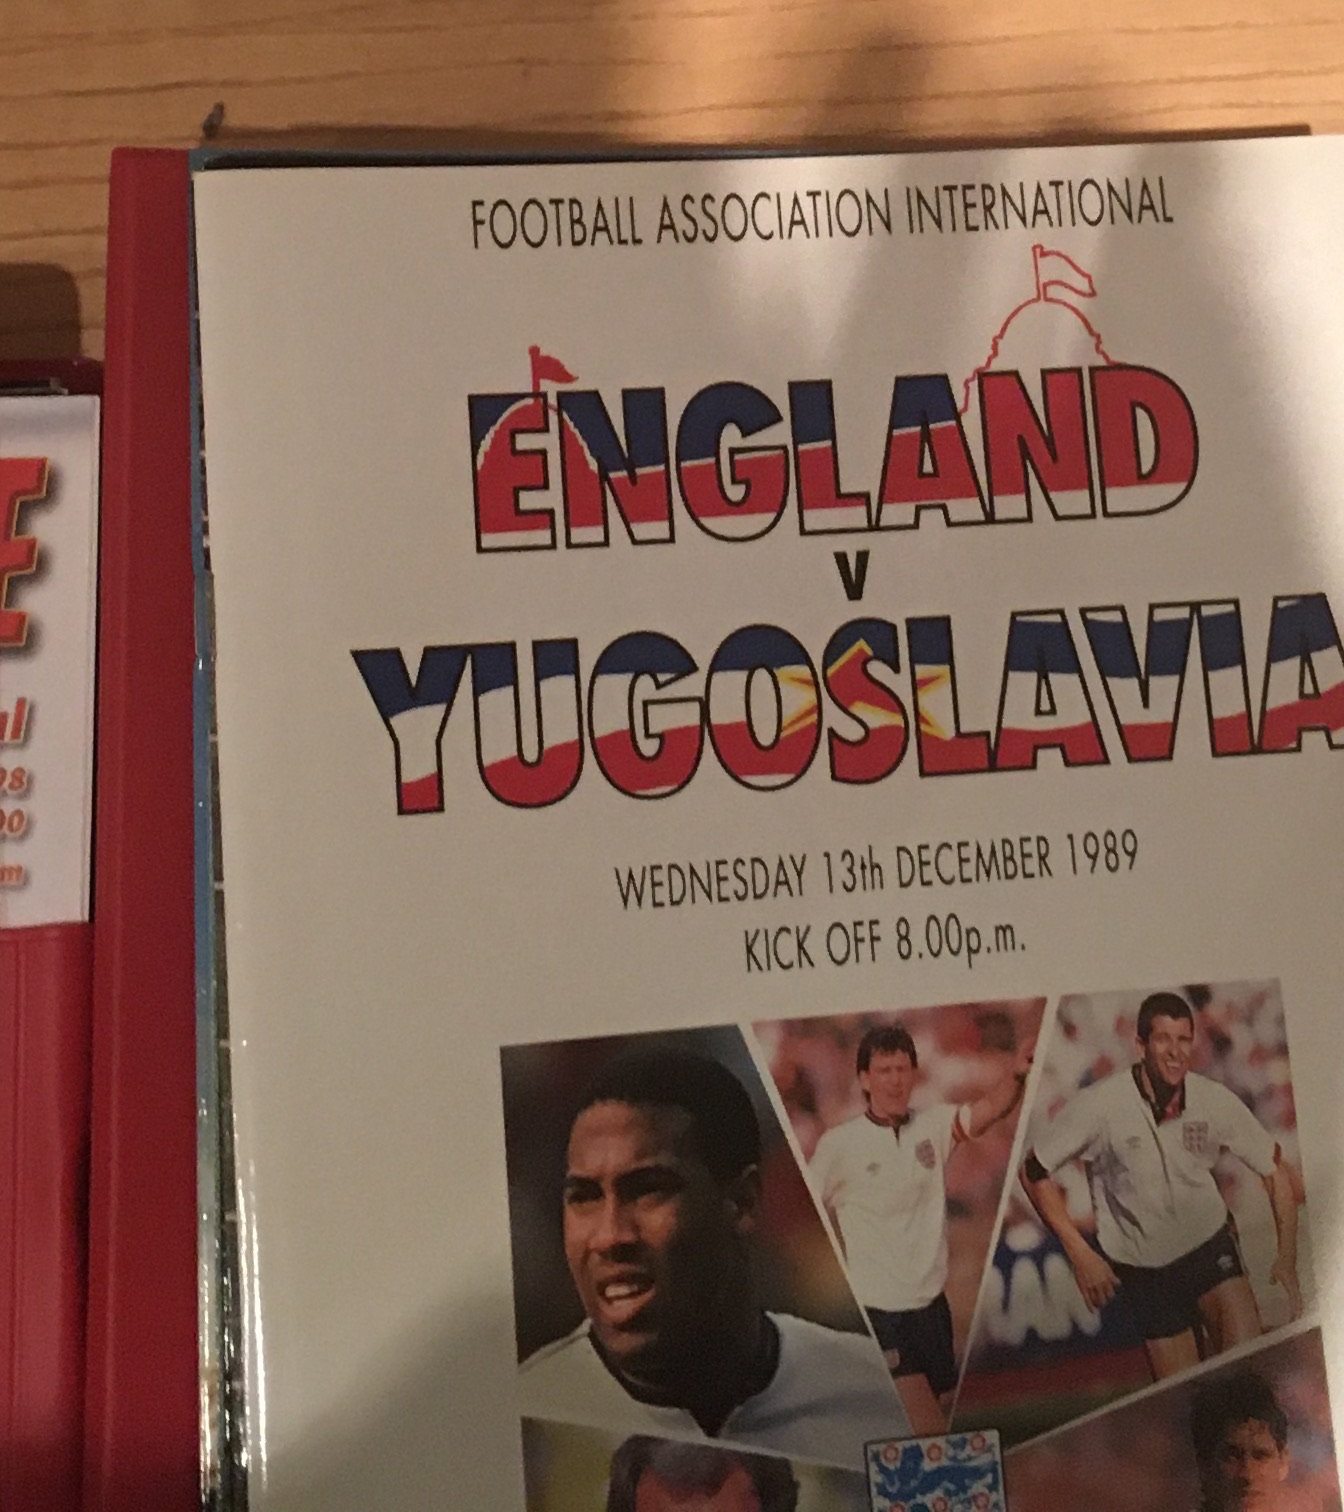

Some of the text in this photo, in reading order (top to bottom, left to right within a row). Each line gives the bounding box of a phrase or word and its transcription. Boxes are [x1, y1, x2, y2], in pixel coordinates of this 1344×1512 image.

[471, 175, 1175, 250] FOOTBALL ASSOCIATION INTERNATIONAL
[466, 363, 1199, 555] ENGLAND
[615, 829, 1140, 912] WEDNESDAY 13th DECEMBER 1989
[744, 913, 1026, 975] KICK OFF 8.00p.m.
